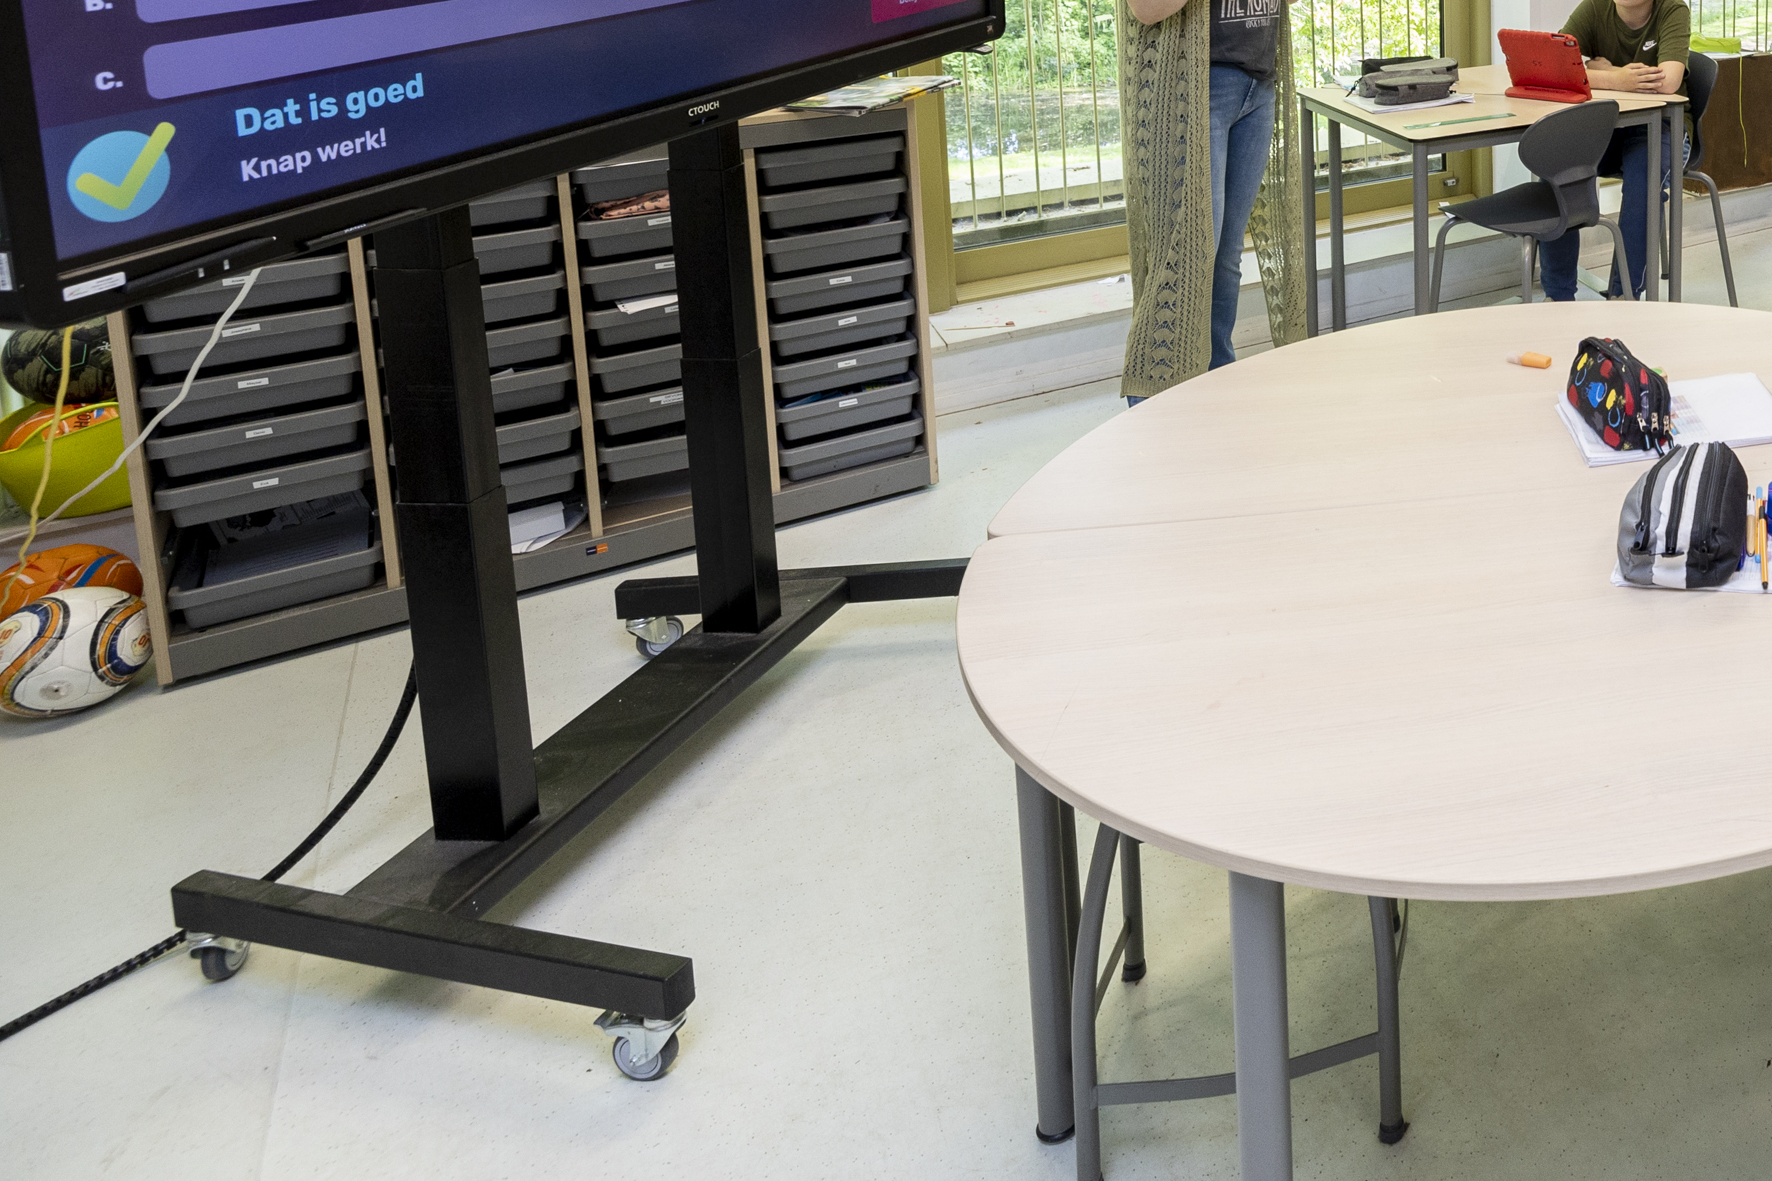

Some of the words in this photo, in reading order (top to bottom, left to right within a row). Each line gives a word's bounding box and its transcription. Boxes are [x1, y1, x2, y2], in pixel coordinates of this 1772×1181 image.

[95, 71, 123, 90] C.
[235, 97, 302, 137] Dat
[309, 92, 339, 122] is
[345, 72, 425, 118] goed
[688, 100, 720, 117] CTOUCH
[240, 148, 312, 183] Knap
[317, 127, 387, 162] werk!
